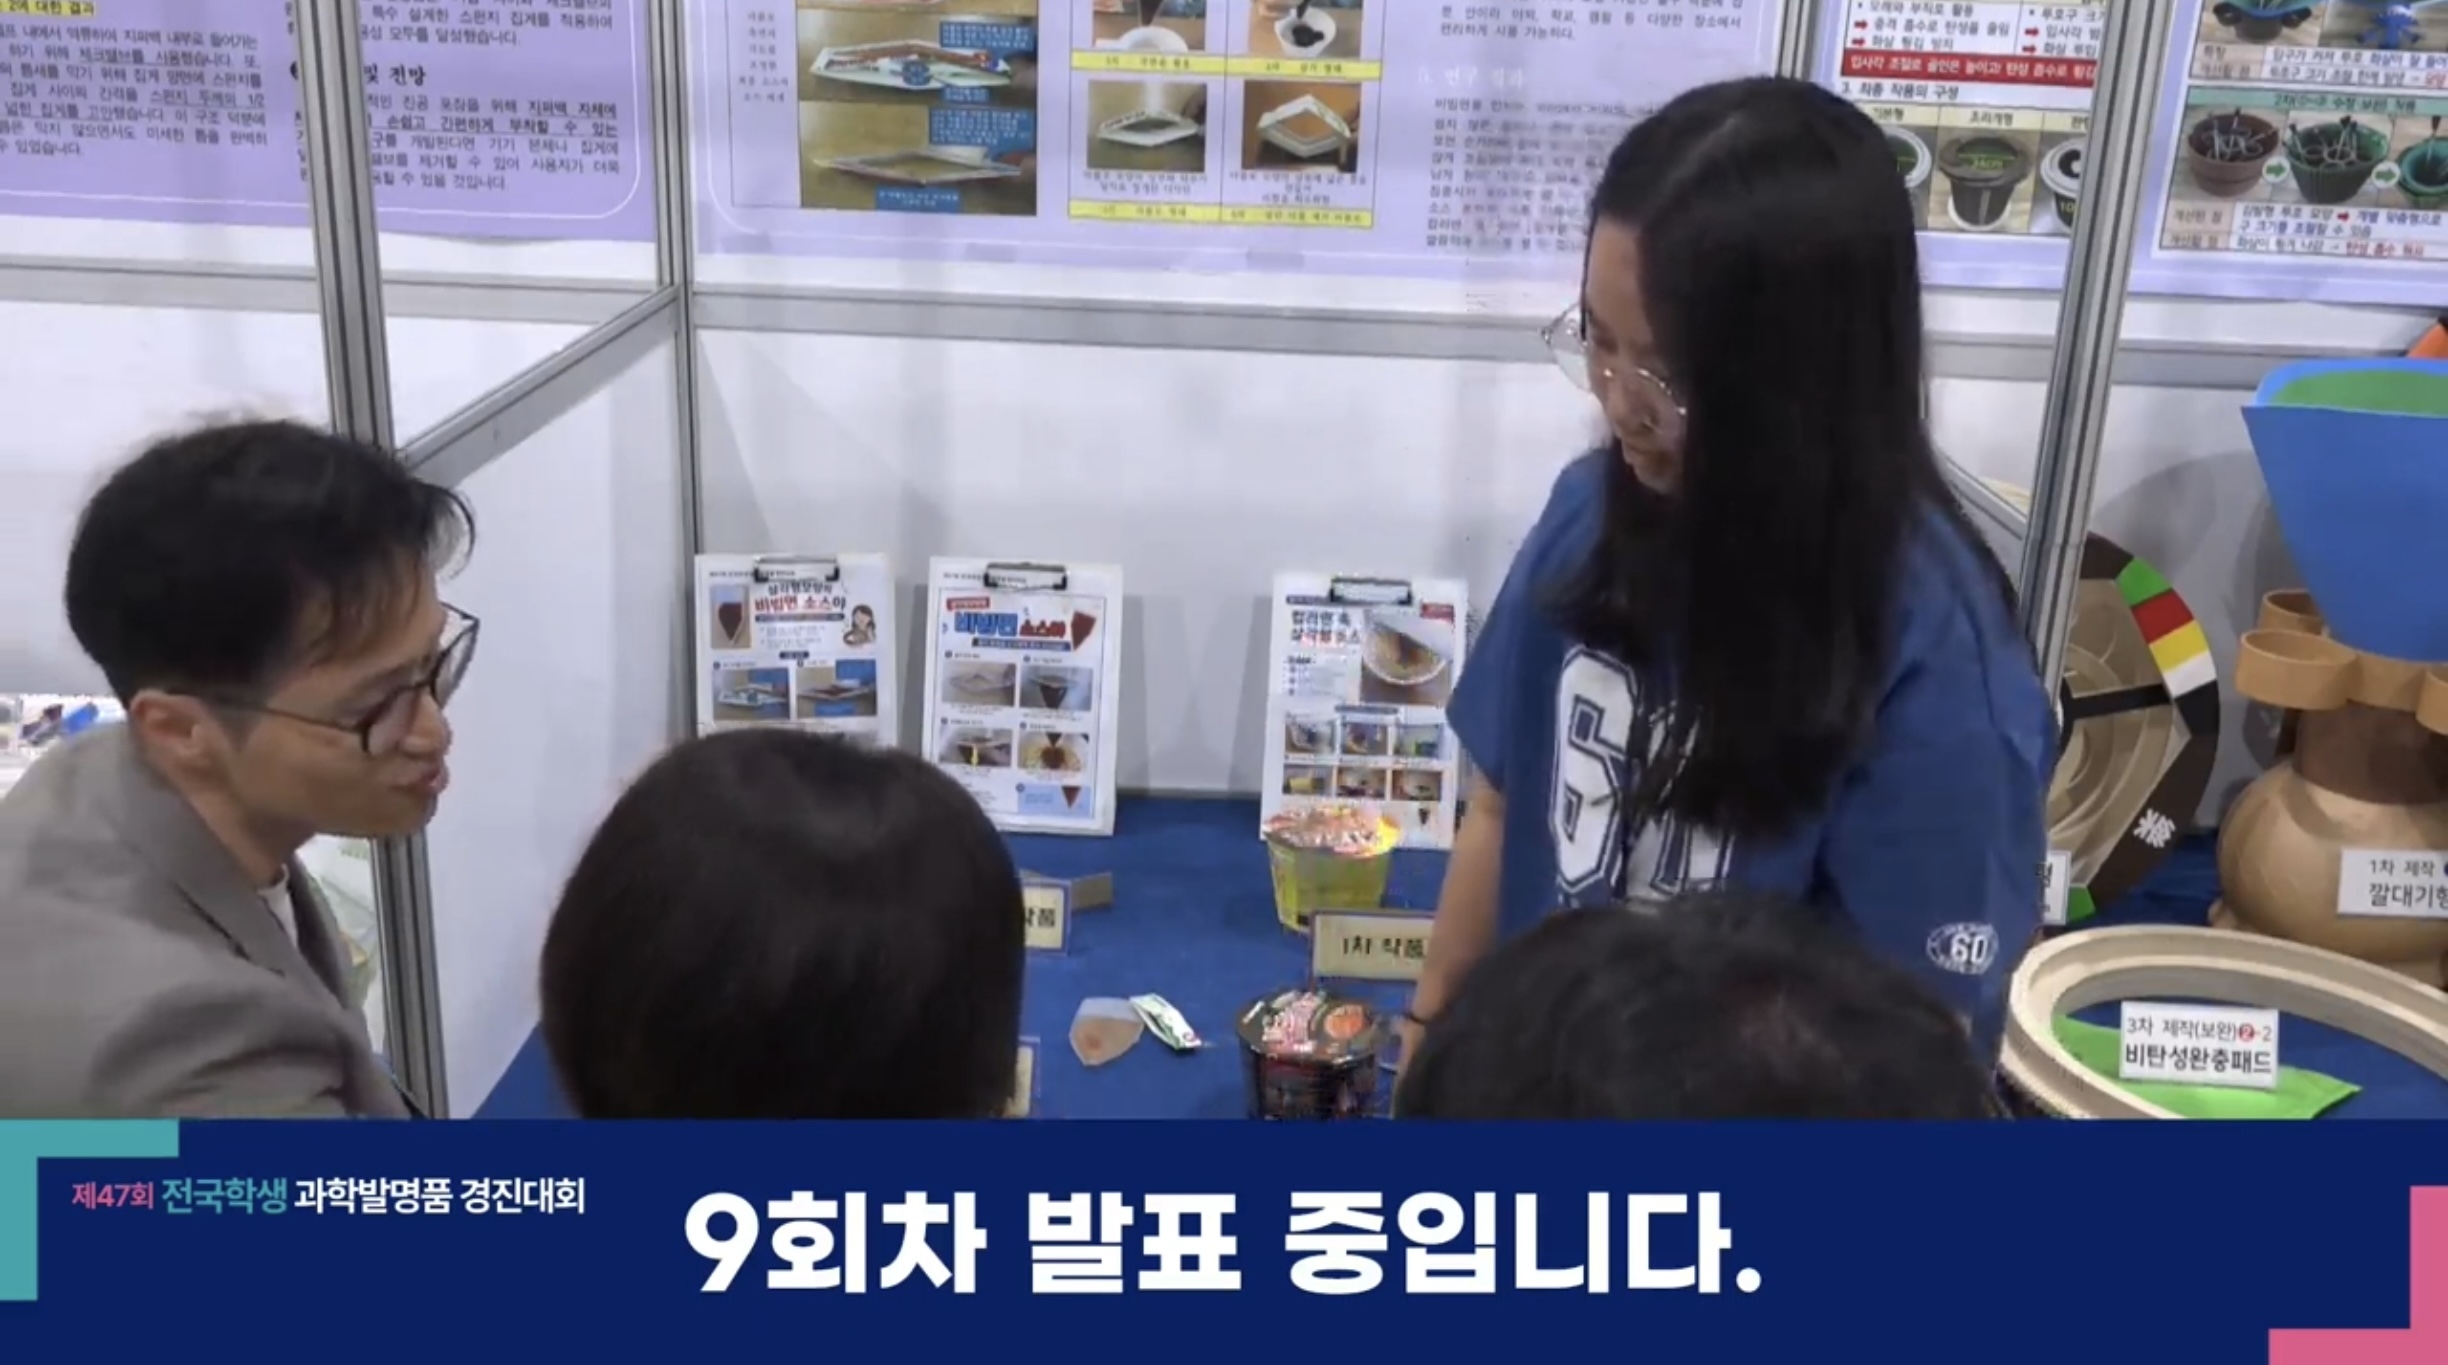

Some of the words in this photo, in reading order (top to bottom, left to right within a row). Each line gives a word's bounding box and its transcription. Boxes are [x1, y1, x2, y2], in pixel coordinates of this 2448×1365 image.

[1850, 55, 1884, 70] 입사각
[2369, 859, 2395, 876] 1차
[2404, 860, 2434, 878] 제작
[1951, 932, 1988, 964] 60
[2127, 1016, 2152, 1036] 3차
[2126, 1043, 2271, 1074] 비탄성완충패드
